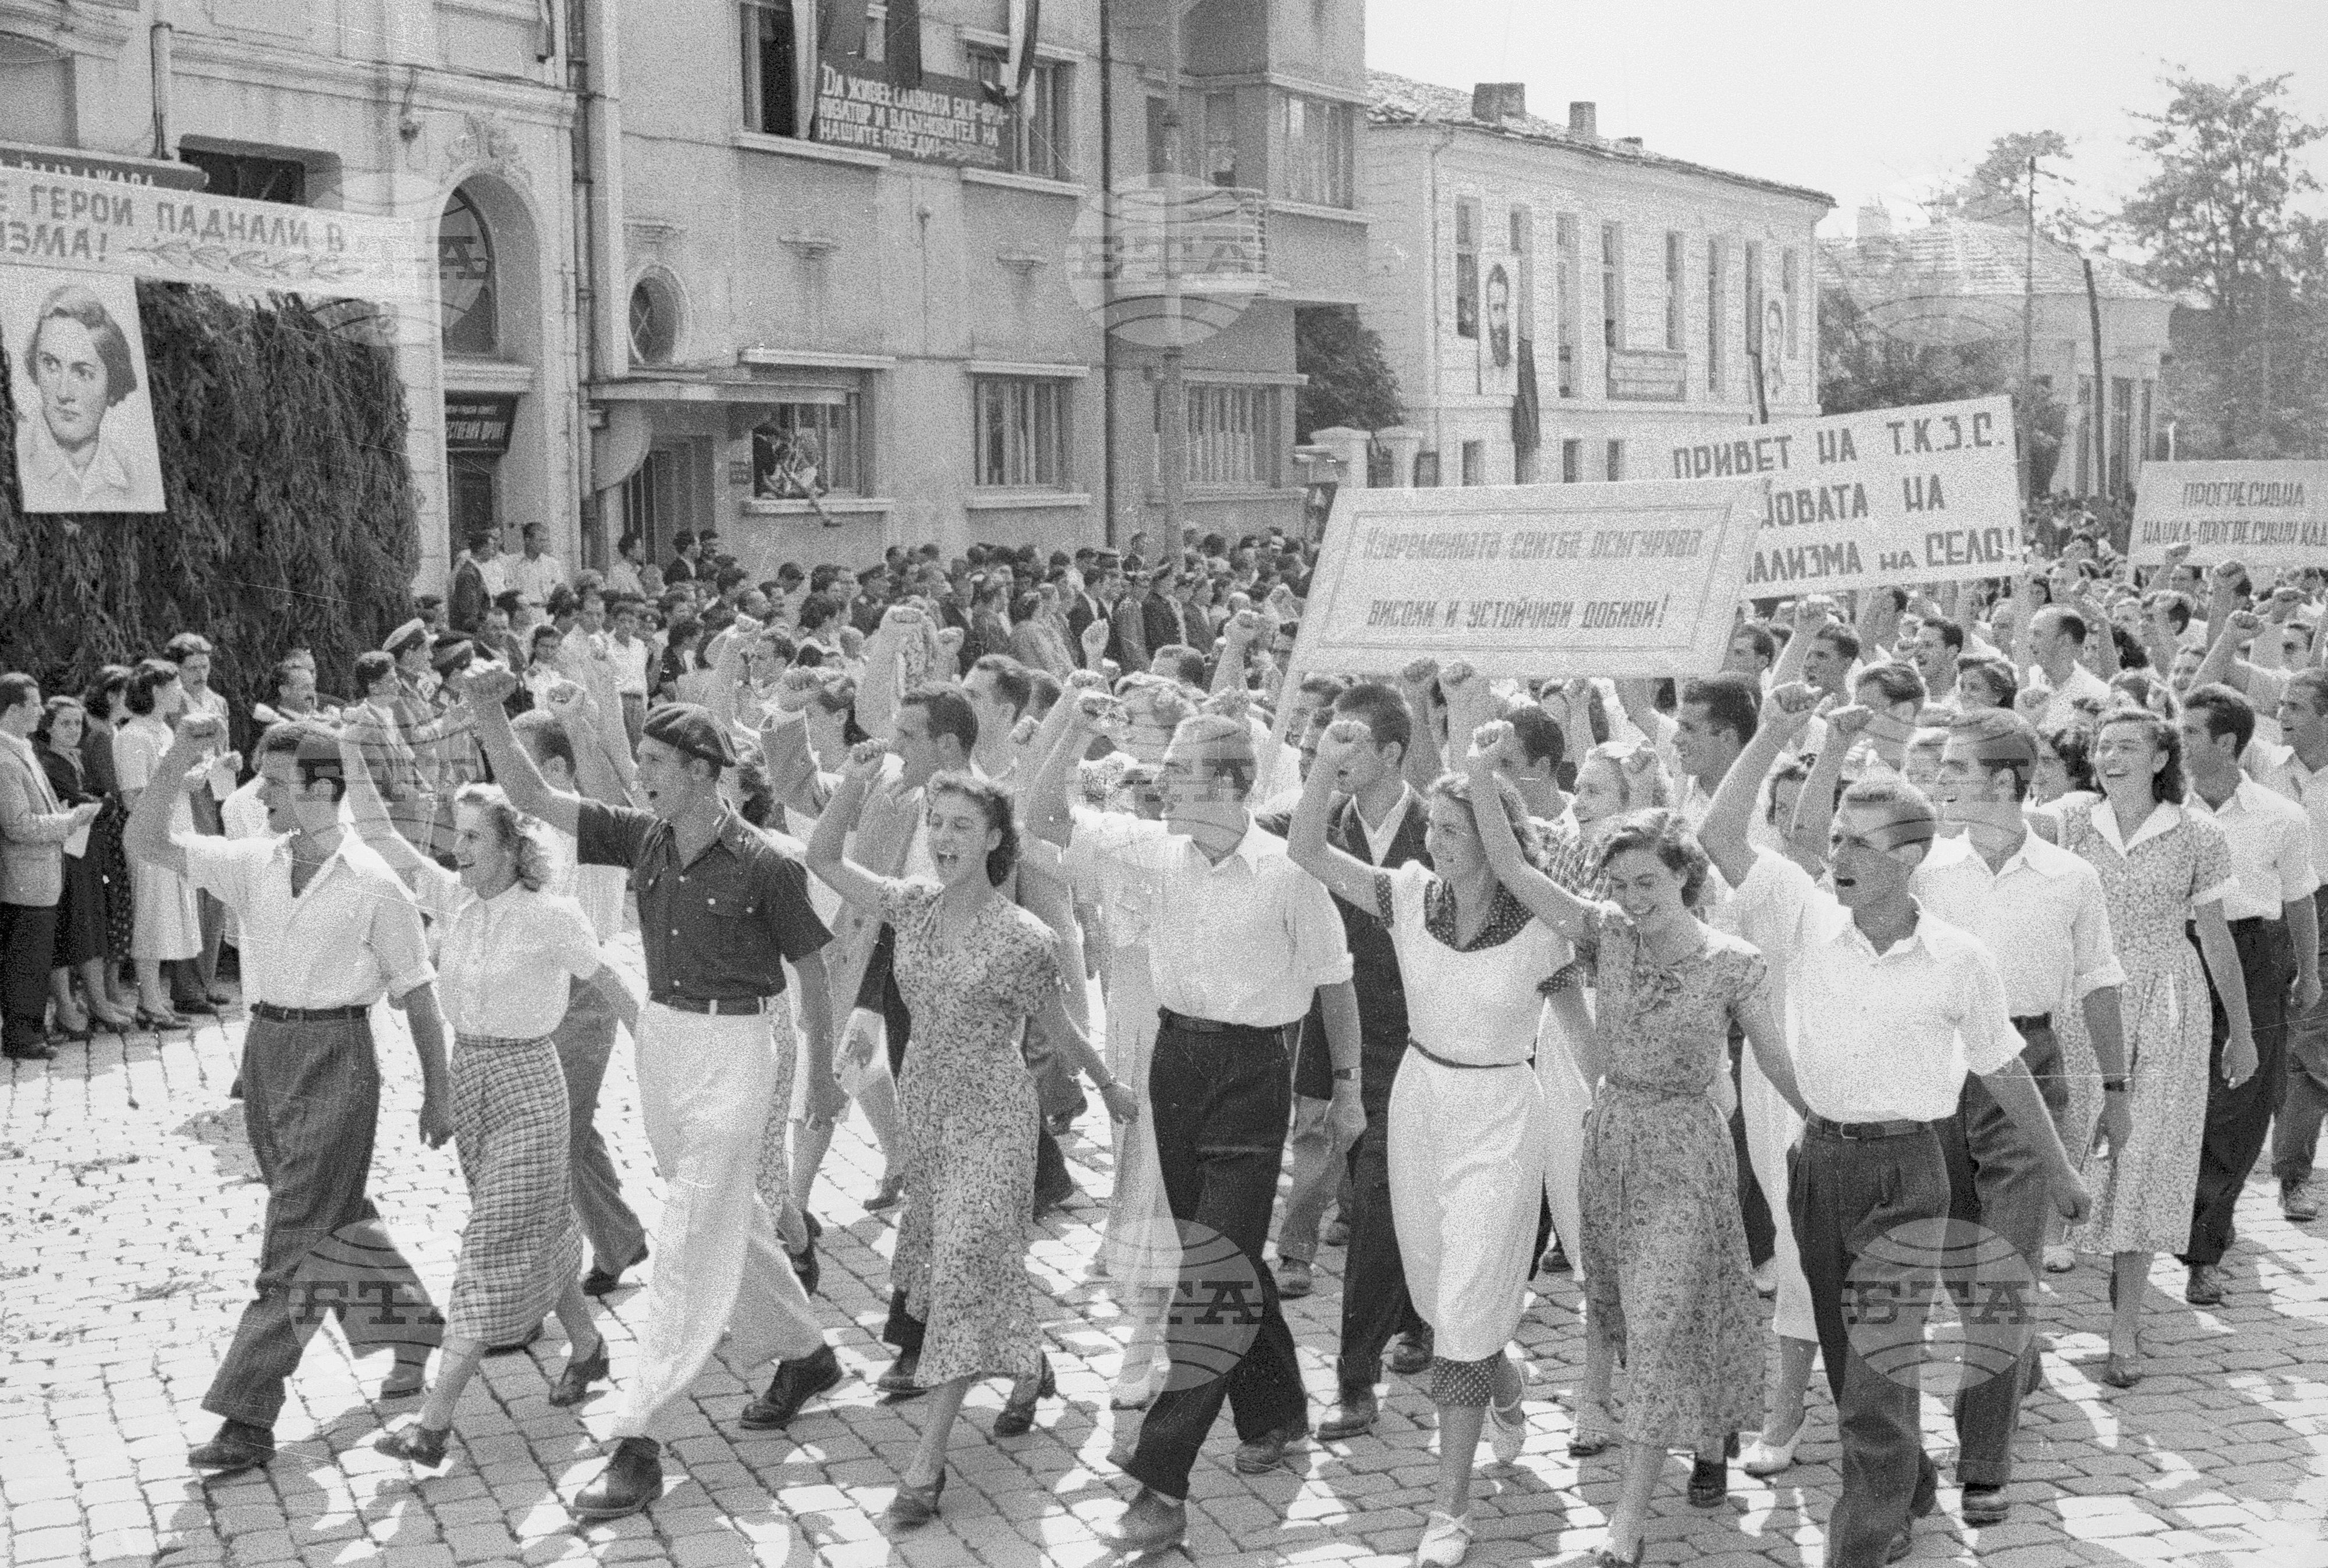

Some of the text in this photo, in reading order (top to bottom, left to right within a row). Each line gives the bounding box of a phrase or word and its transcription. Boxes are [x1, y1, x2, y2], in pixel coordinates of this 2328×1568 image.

[818, 118, 882, 147] НАШИТЕ
[875, 106, 885, 128] И
[982, 123, 999, 147] НА
[31, 184, 133, 227] ГЕРОИ
[157, 202, 309, 250] ПАДНАЛИ
[327, 222, 345, 253] В
[0, 221, 107, 262] ЗМА!
[1673, 435, 1792, 479] ПРИВЕТ
[1817, 428, 1857, 464] НА
[1903, 474, 1945, 512] НА
[1925, 527, 2017, 567] СЕЛО!
